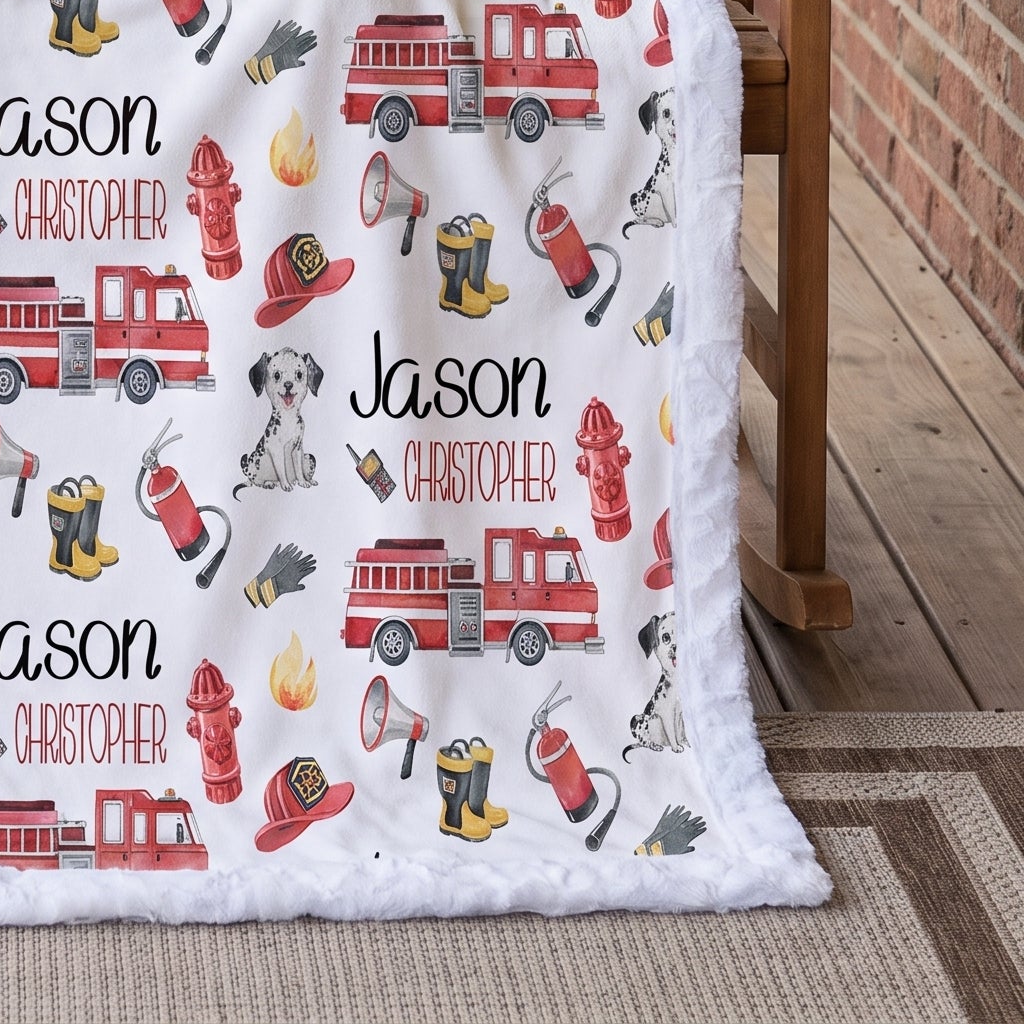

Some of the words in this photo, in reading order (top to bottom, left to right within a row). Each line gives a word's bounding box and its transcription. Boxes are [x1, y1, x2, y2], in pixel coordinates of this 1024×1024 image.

[15, 179, 167, 241] CHRISTOPHER
[350, 329, 552, 420] Jason
[404, 441, 556, 503] CHRISTOPHER
[15, 703, 167, 765] CHRISTOPHER
